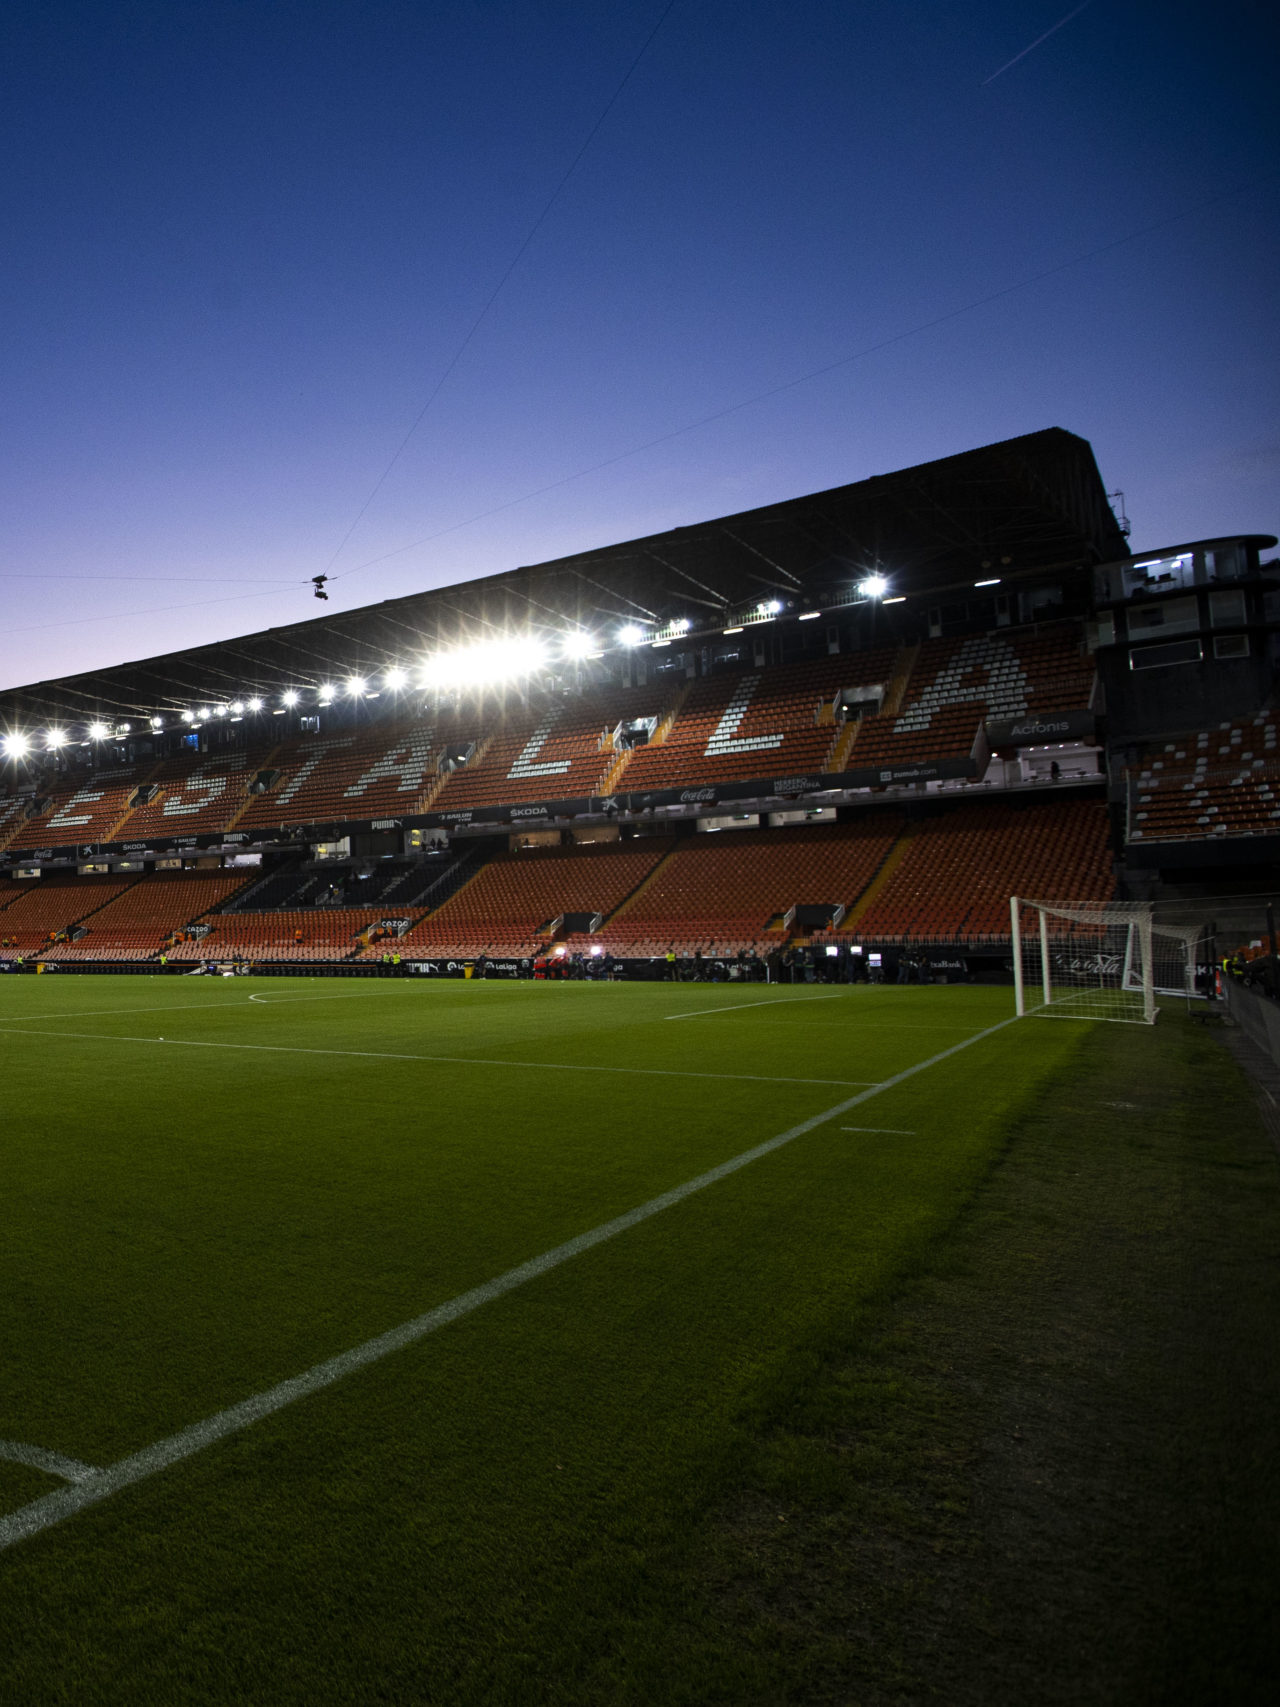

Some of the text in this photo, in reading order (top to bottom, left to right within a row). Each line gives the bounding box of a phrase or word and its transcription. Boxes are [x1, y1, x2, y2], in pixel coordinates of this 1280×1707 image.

[1011, 721, 1069, 736] Acronis
[893, 768, 937, 778] zumub.com
[510, 807, 548, 817] ŠKODA
[372, 819, 395, 830] PUMA
[224, 834, 243, 842] PUMA
[122, 843, 147, 851] ŠKODA
